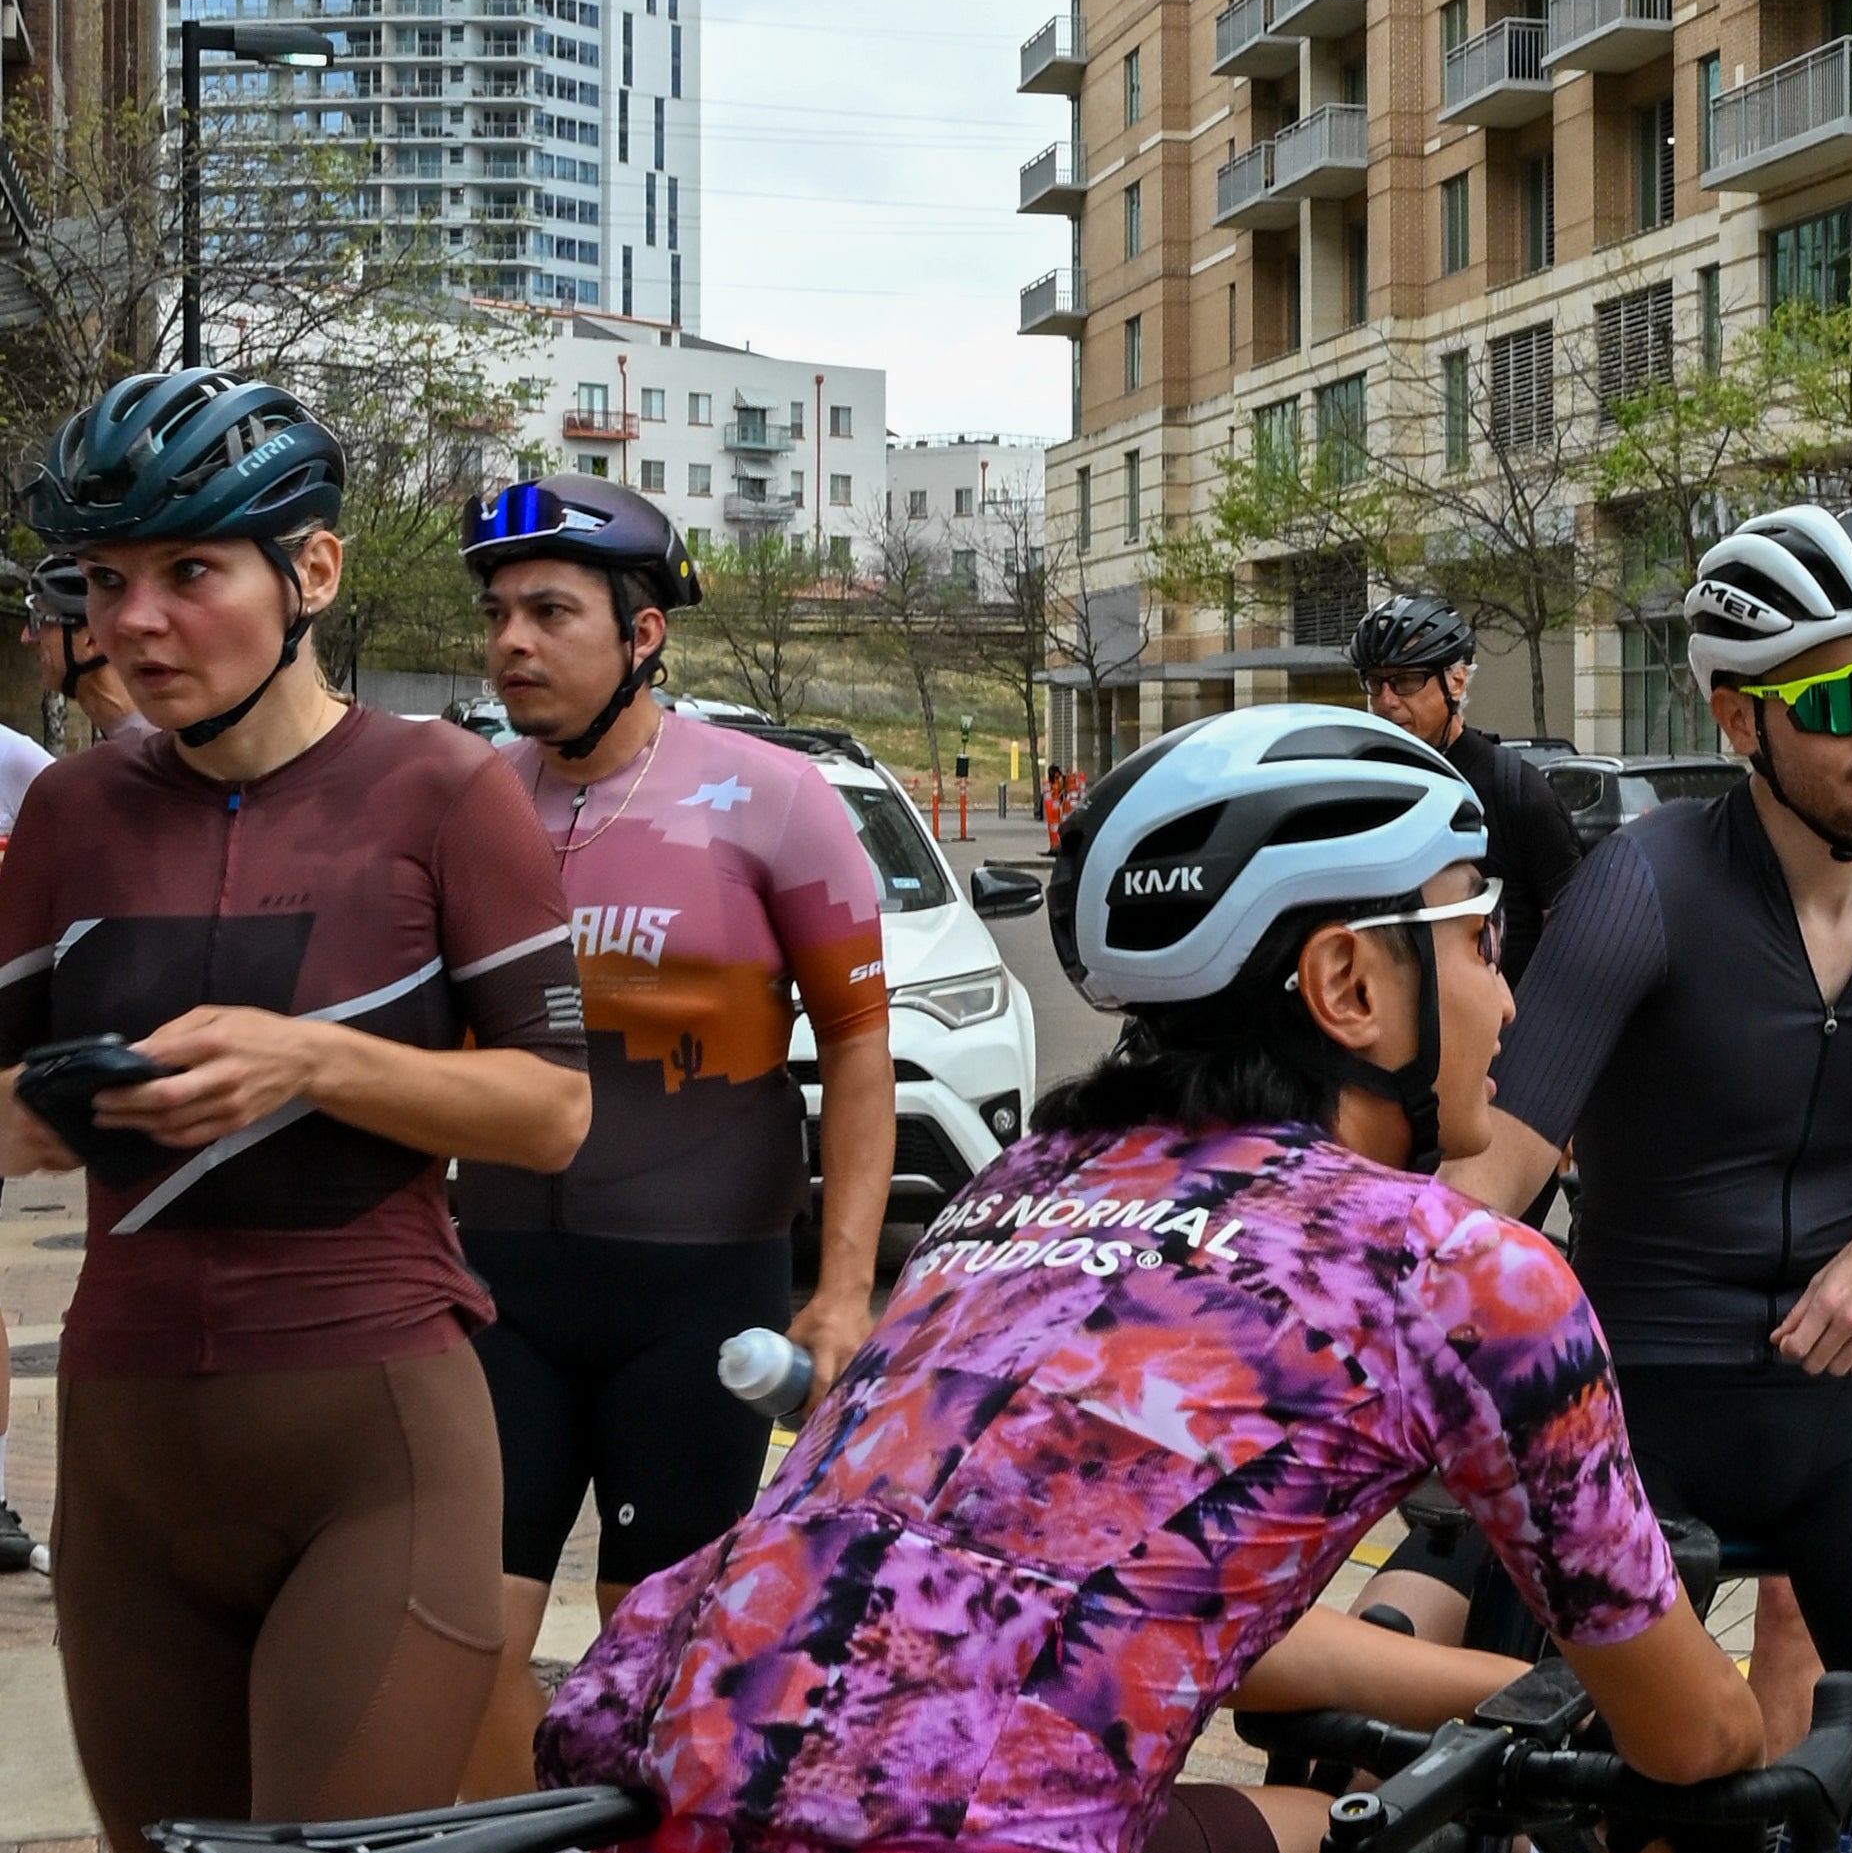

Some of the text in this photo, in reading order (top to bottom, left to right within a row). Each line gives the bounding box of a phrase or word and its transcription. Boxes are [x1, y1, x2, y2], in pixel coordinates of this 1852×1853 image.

[1700, 583, 1770, 621] MET
[1125, 866, 1204, 896] KASK
[924, 1194, 1243, 1263] PAS NORMAL
